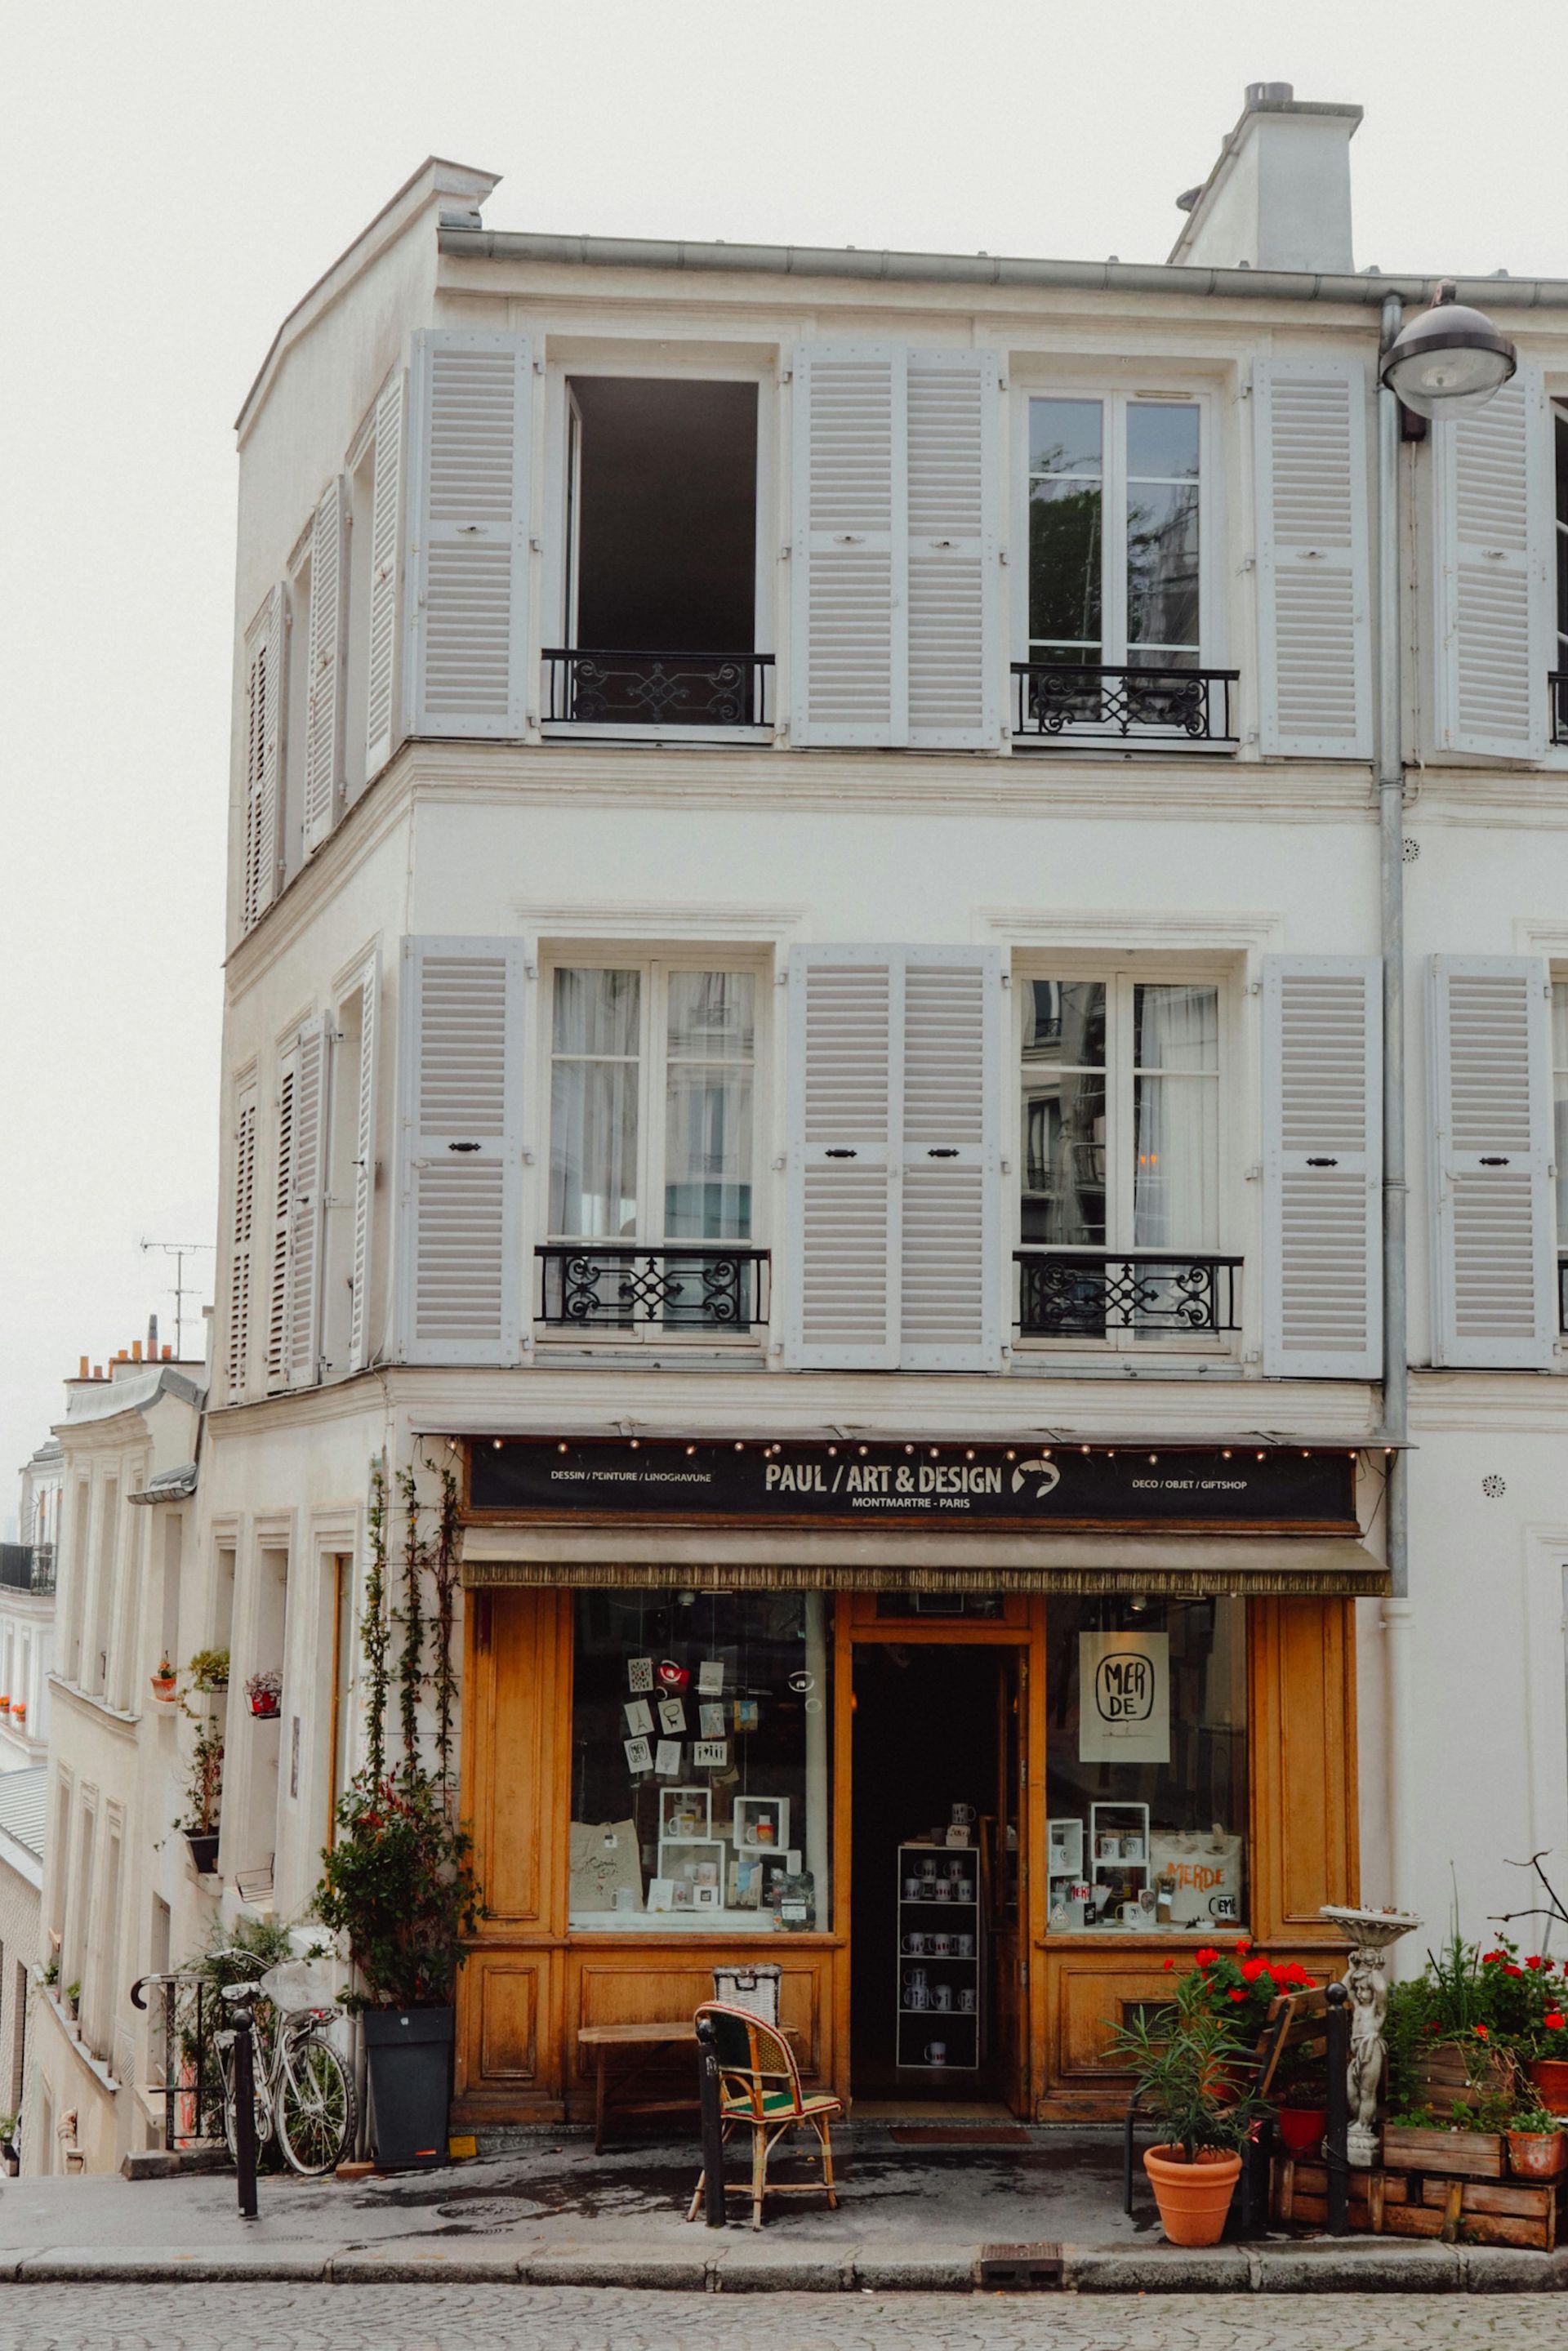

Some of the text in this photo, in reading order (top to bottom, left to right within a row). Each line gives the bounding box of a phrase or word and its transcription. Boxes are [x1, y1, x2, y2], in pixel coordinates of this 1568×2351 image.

[550, 1471, 585, 1480] DESSIN
[592, 1472, 638, 1481] PEINTURE
[645, 1472, 712, 1483] LINOGRAVURE
[765, 1464, 827, 1492] PAUL
[846, 1465, 892, 1493] ART
[895, 1465, 915, 1493] &
[919, 1466, 1002, 1494] DESIGN
[1132, 1480, 1159, 1489] DECO
[1165, 1480, 1195, 1489] OBJET
[1200, 1481, 1248, 1490] GIFTSHOP
[852, 1498, 932, 1508] MONTMARTRE
[939, 1498, 971, 1508] PARIS
[1105, 1662, 1146, 1700] MER
[1109, 1696, 1138, 1716] DE
[1166, 1861, 1225, 1893] MERDE
